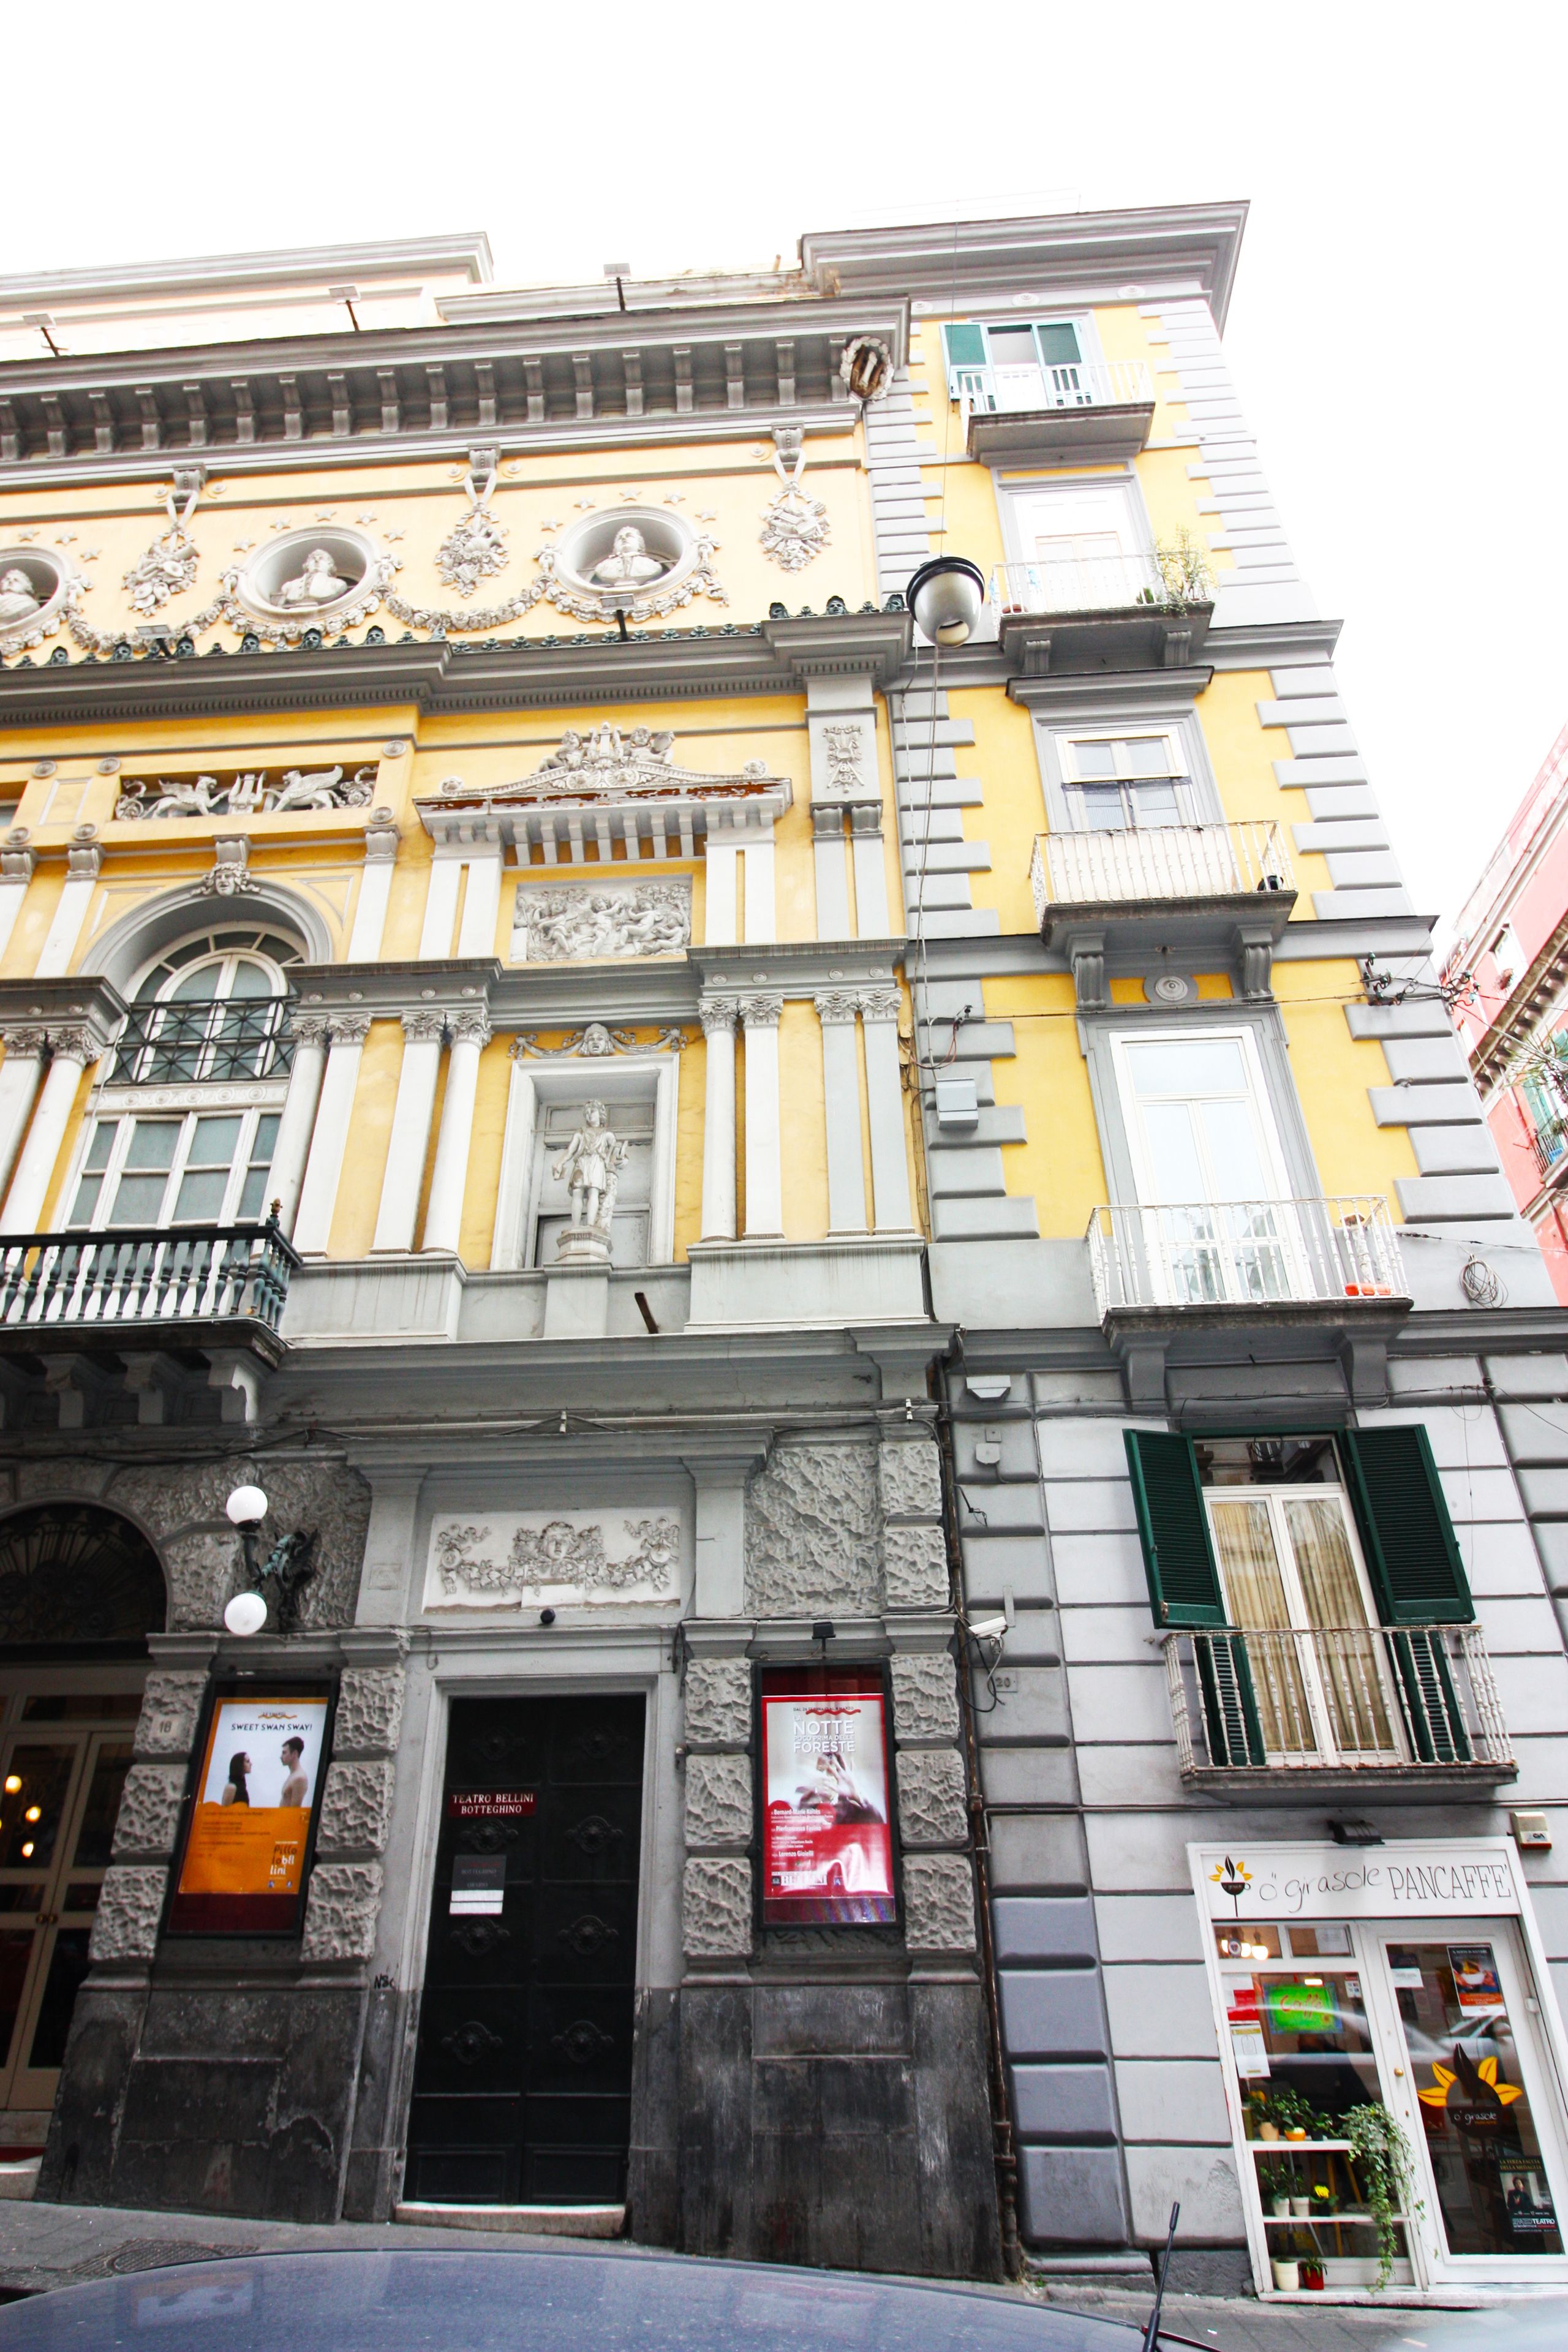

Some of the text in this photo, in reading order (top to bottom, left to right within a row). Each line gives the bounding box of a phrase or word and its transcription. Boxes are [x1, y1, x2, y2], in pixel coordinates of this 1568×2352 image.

[995, 1677, 1011, 1687] 20
[160, 1721, 172, 1733] 18
[794, 1721, 854, 1735] NOTTE
[794, 1741, 856, 1753] FORESTE
[453, 1793, 533, 1804] TEATRO BELLINI
[461, 1804, 522, 1814] BOTTEGHINO
[1284, 1864, 1382, 1913] girasole
